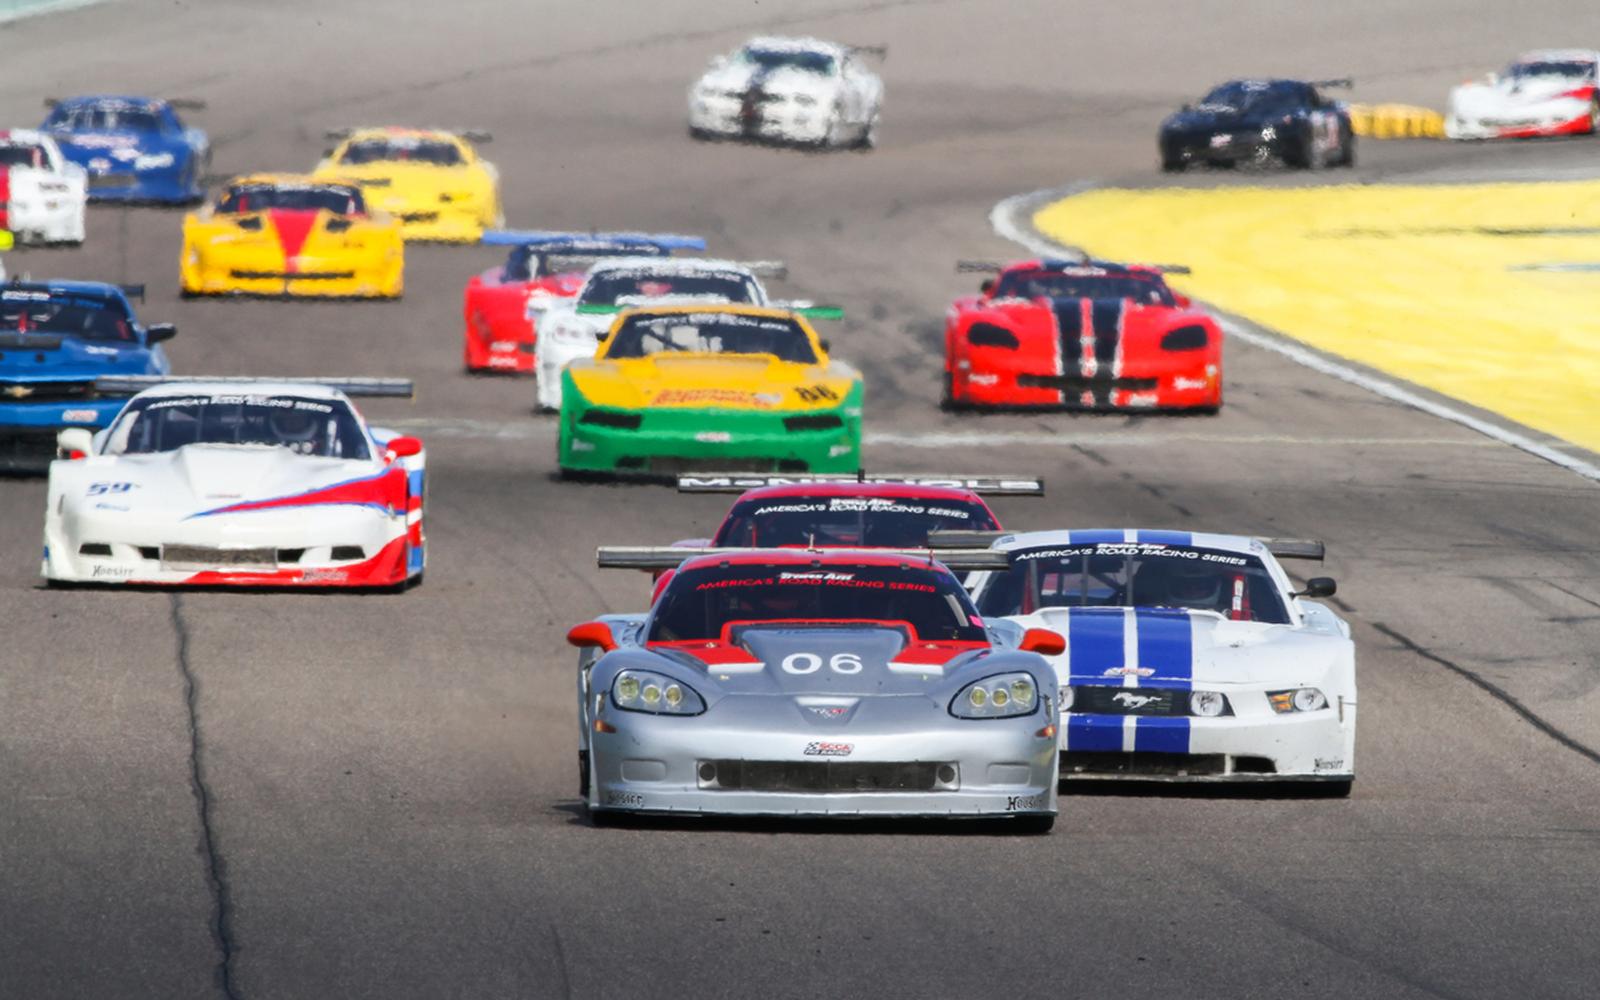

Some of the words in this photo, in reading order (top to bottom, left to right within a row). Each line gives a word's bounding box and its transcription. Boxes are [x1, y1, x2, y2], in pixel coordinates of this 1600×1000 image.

[86, 481, 132, 496] 59
[754, 504, 827, 515] AMERICA'S
[829, 503, 868, 512] ROAD
[870, 504, 924, 514] RACING
[928, 507, 969, 519] SERIES
[1015, 547, 1093, 561] AMERICA'S
[1095, 547, 1140, 556] ROAD
[1142, 548, 1199, 559] RACING
[1202, 553, 1247, 566] SERIES
[696, 578, 774, 591] AMERICA'S
[778, 577, 823, 586] ROAD
[827, 578, 885, 589] RACING
[888, 581, 936, 593] SERIES
